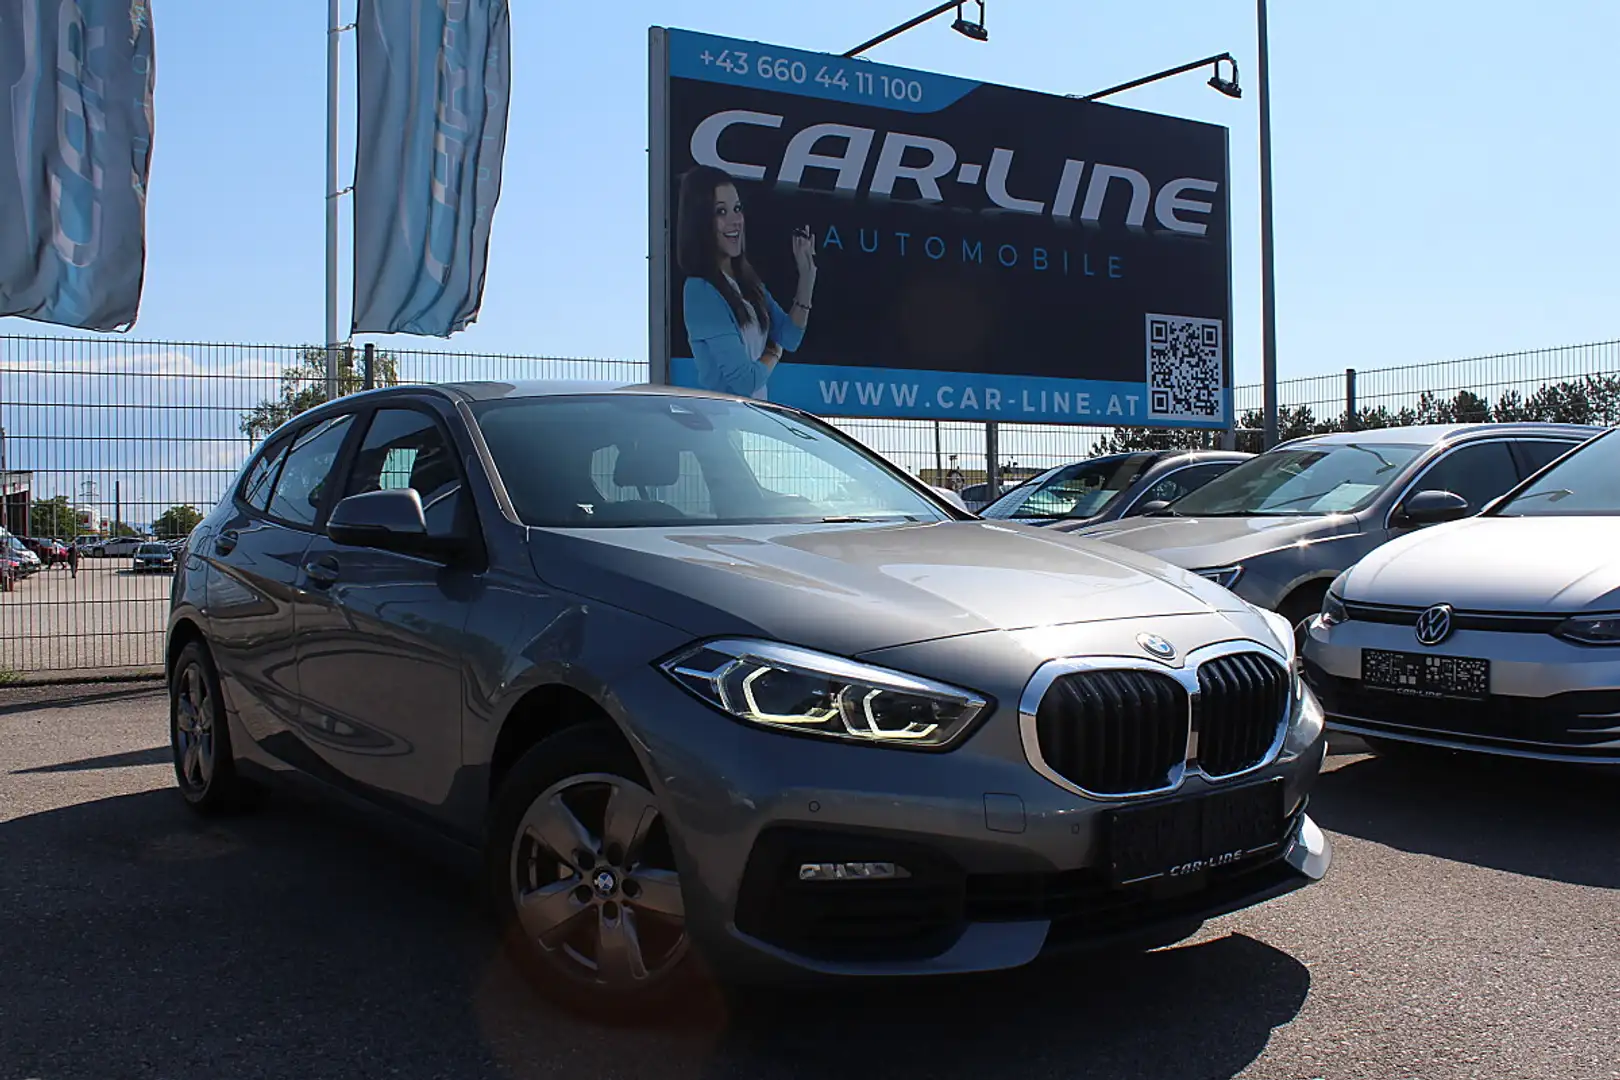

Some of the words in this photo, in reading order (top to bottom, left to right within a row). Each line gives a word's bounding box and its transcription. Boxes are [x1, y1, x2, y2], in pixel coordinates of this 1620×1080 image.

[700, 50, 748, 75] +43
[757, 56, 806, 84] 660
[814, 65, 848, 91] 44
[855, 71, 873, 95] 11
[880, 75, 922, 102] 100
[689, 109, 1219, 236] CAR-LINE
[822, 225, 1124, 278] AUTOMOBILE
[819, 380, 1140, 416] WWW.CAR-LINE.AT
[1170, 849, 1243, 877] CAR-LINE
